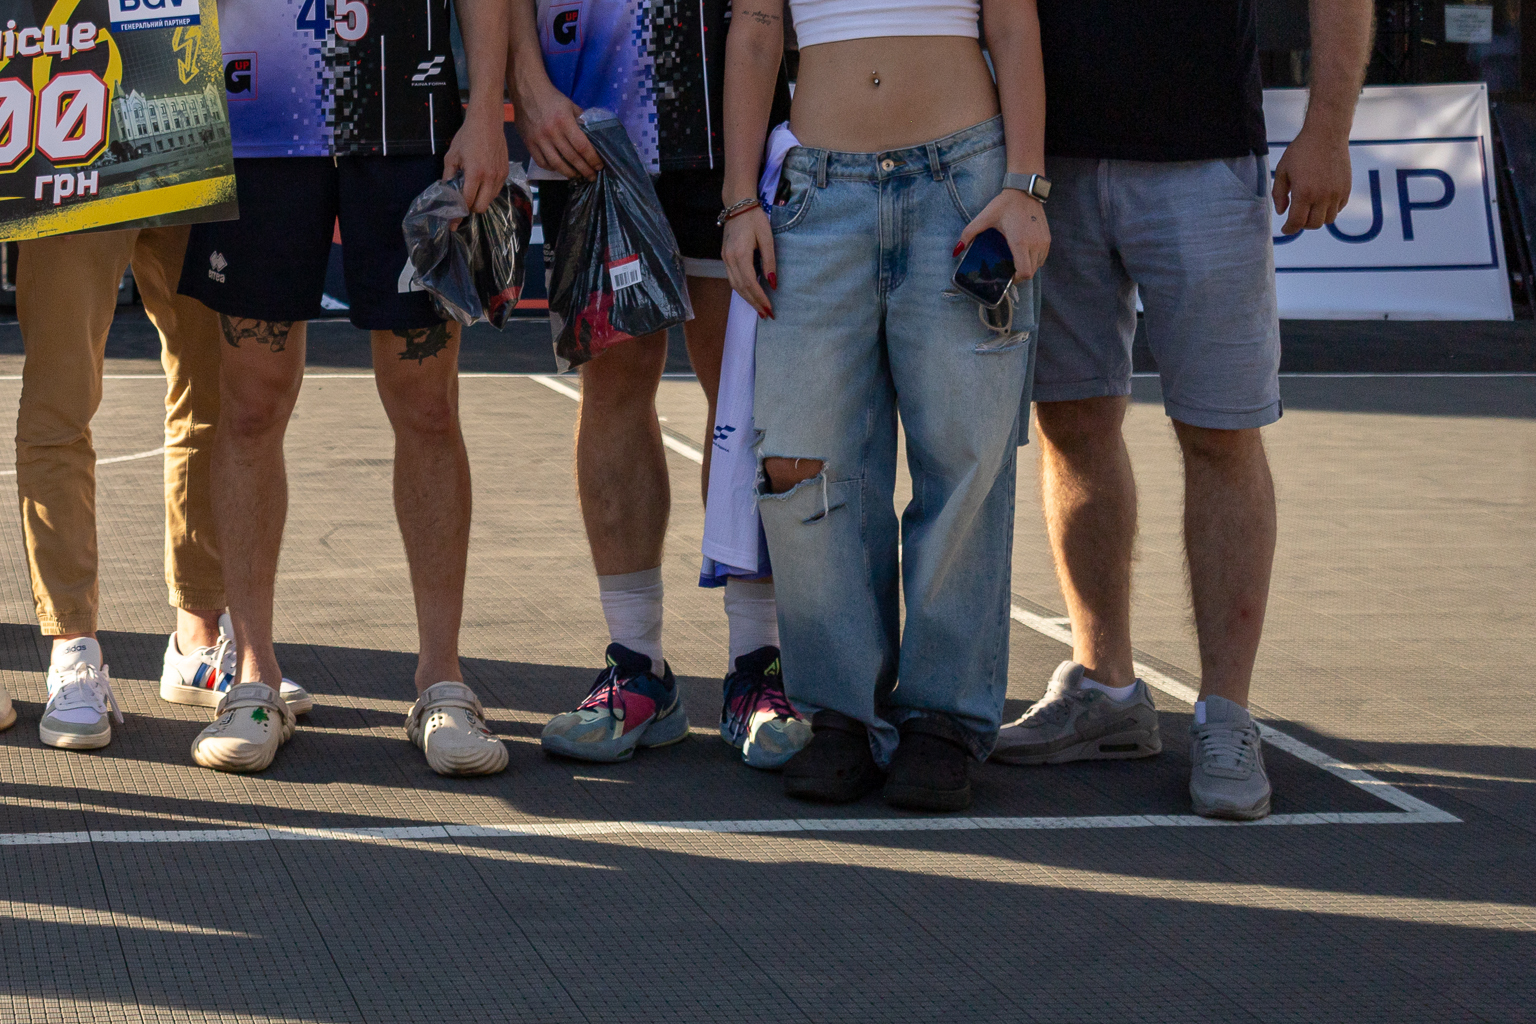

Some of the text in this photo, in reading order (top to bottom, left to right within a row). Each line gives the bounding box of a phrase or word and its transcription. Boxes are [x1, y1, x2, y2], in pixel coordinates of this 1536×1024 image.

[565, 12, 579, 21] UP
[121, 18, 191, 31] ГЕНЕРАЛЬНИЙ ПАРТНЕР
[235, 61, 249, 71] UP
[34, 170, 99, 205] грн
